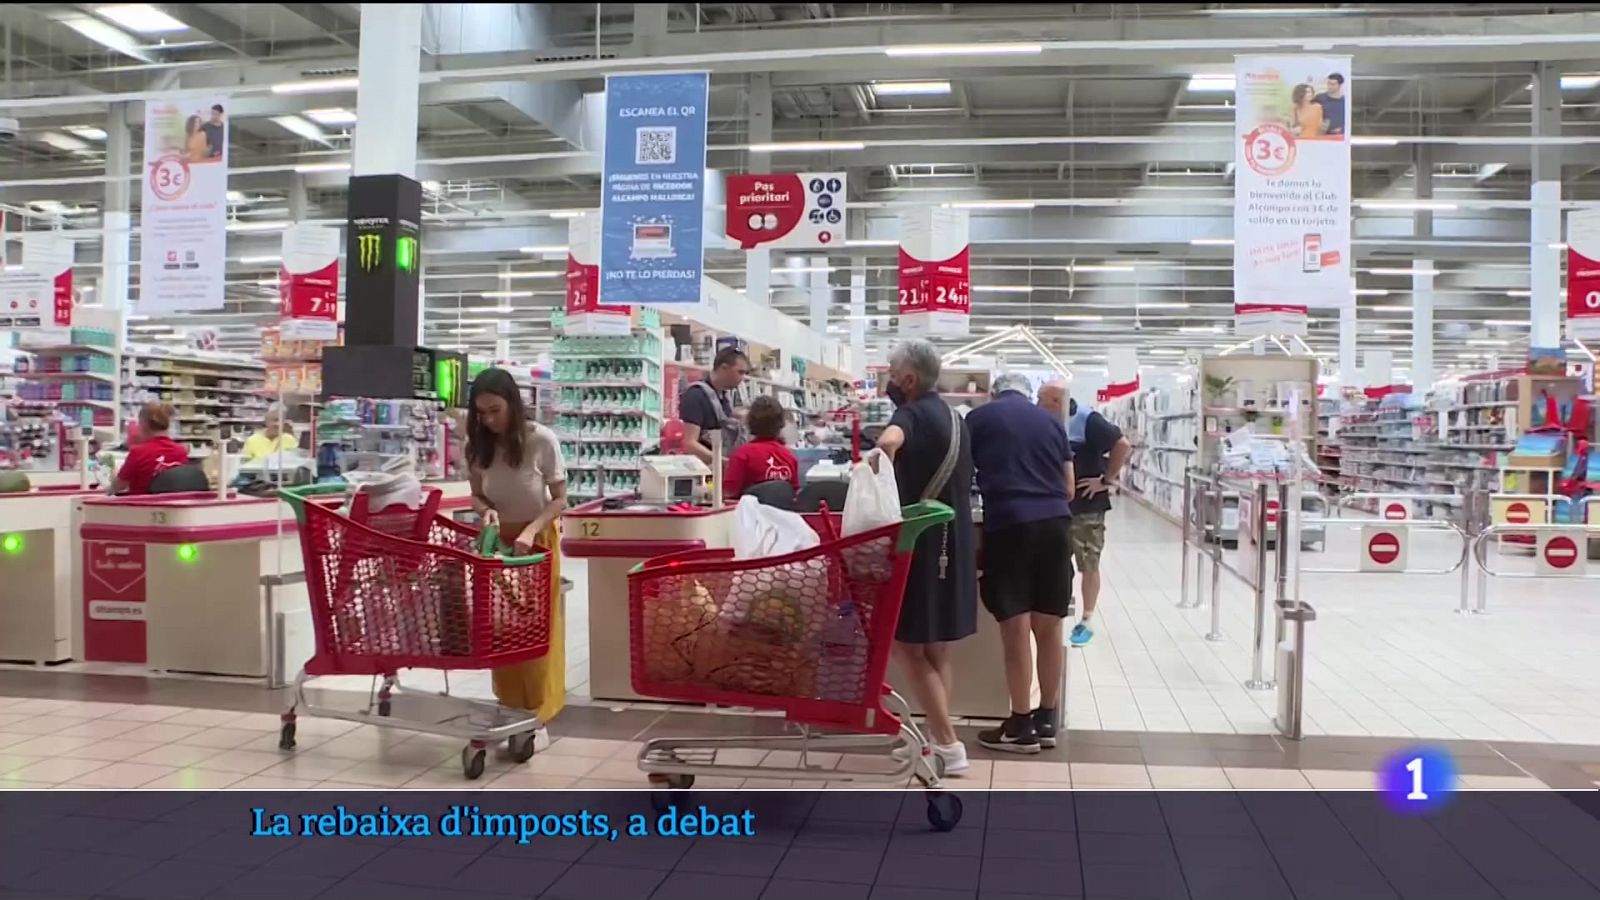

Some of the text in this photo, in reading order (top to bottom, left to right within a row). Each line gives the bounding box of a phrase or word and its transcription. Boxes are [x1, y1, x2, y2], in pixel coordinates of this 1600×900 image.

[619, 106, 696, 117] ESCANEA EL QR
[662, 172, 699, 180] NUESTRA
[754, 181, 775, 192] Pas
[740, 191, 790, 205] prioritari
[625, 270, 637, 280] TE
[638, 270, 650, 279] LO
[652, 269, 696, 279] PIERDAS!
[151, 511, 167, 524] 13
[581, 521, 601, 537] 12
